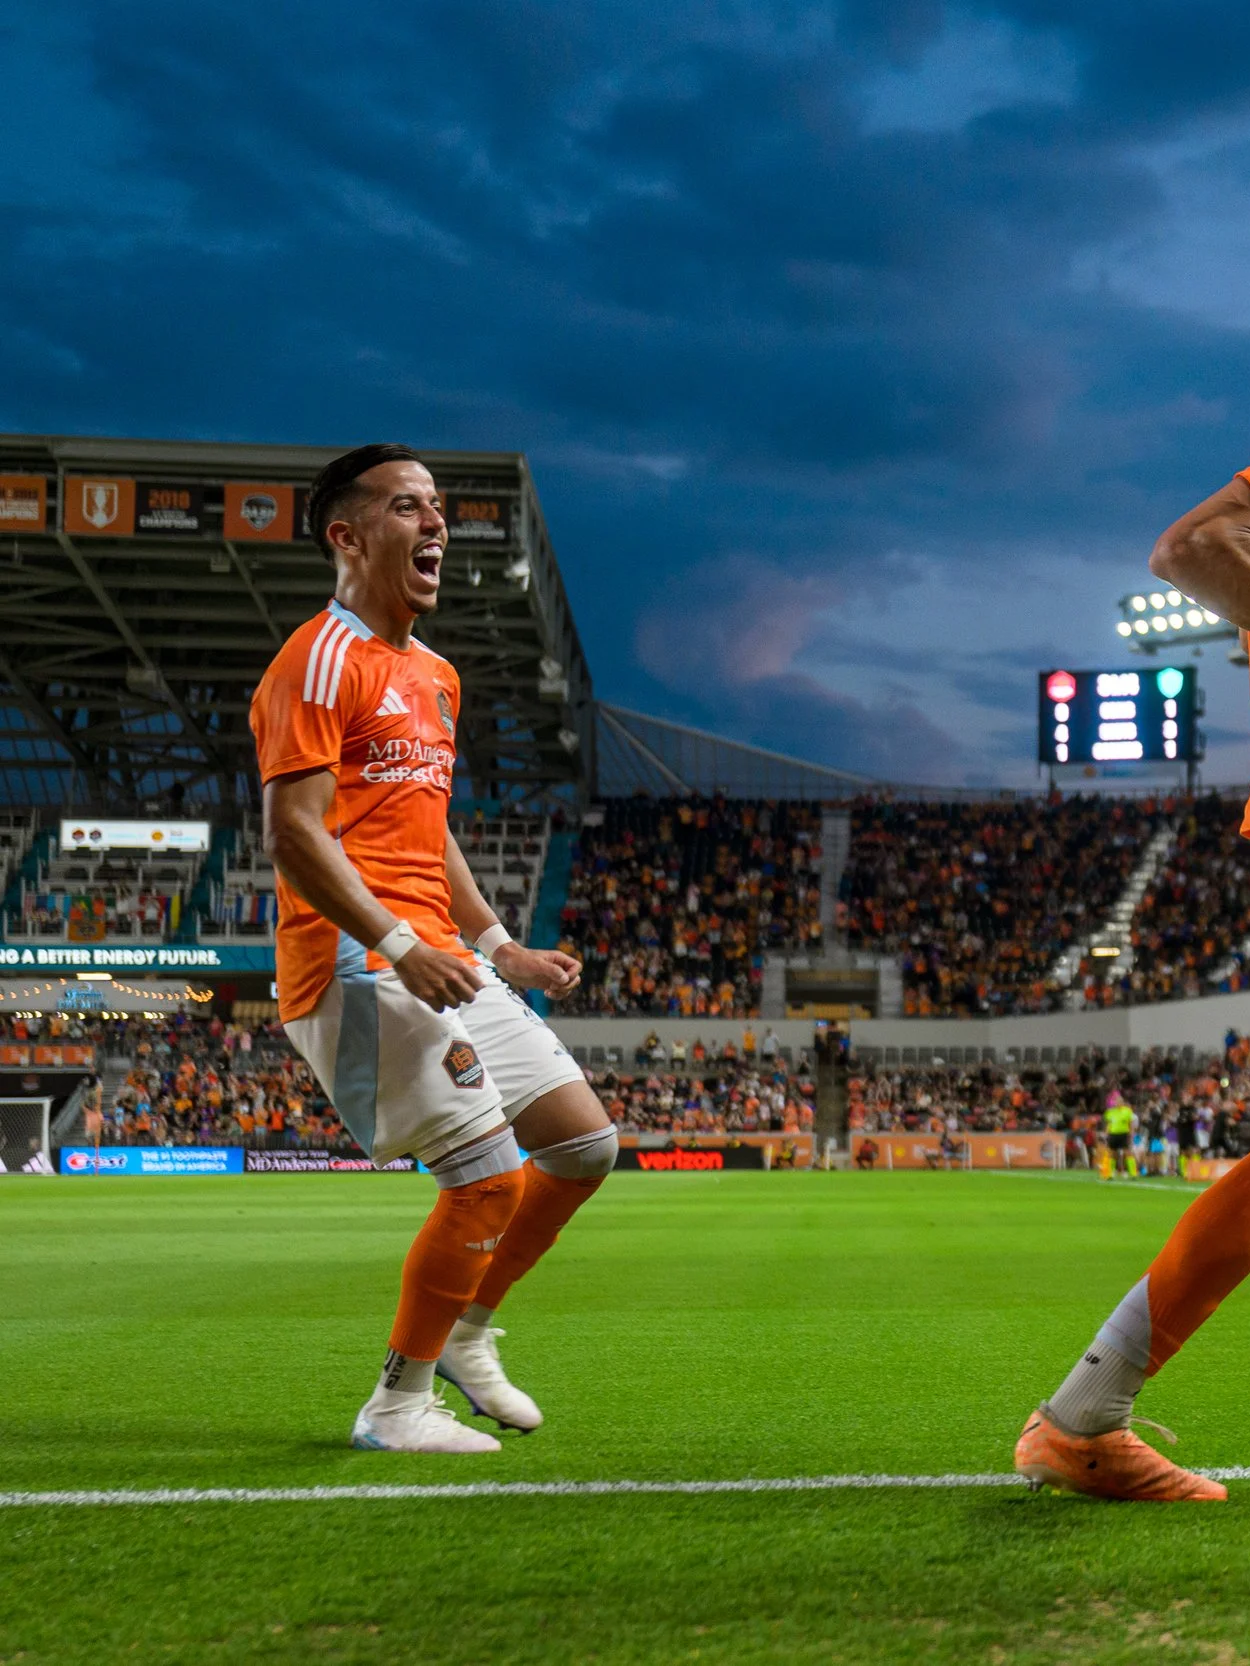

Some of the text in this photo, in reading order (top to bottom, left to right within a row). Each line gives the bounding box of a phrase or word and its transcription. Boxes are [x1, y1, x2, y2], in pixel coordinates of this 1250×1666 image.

[21, 949, 35, 964] A
[37, 950, 91, 965] BETTER
[94, 950, 156, 965] ENERGY
[159, 950, 221, 965] FUTURE.
[637, 1146, 724, 1170] verizon
